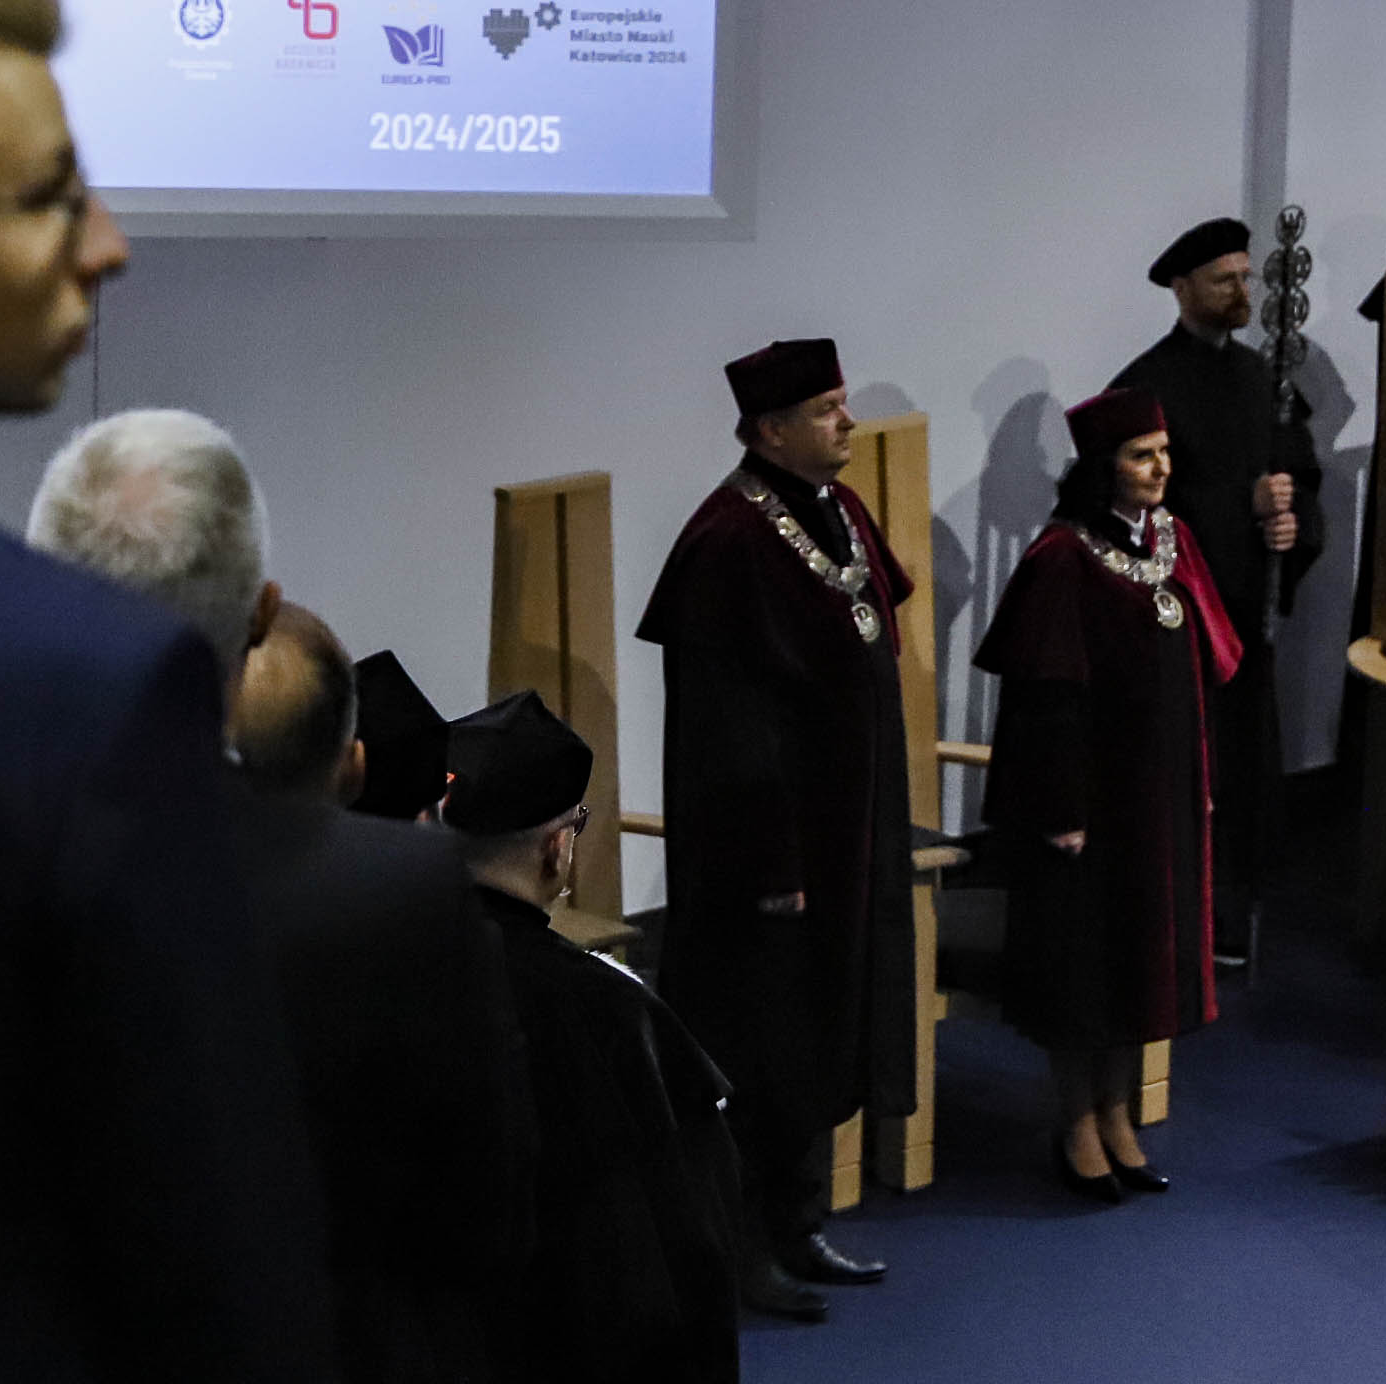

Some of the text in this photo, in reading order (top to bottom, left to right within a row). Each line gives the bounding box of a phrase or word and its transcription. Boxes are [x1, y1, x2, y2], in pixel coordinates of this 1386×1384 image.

[571, 8, 662, 25] Europejskie
[570, 29, 673, 42] Miasto Nauki
[570, 50, 686, 63] Katowice 2024
[371, 112, 560, 153] 2024/2025
